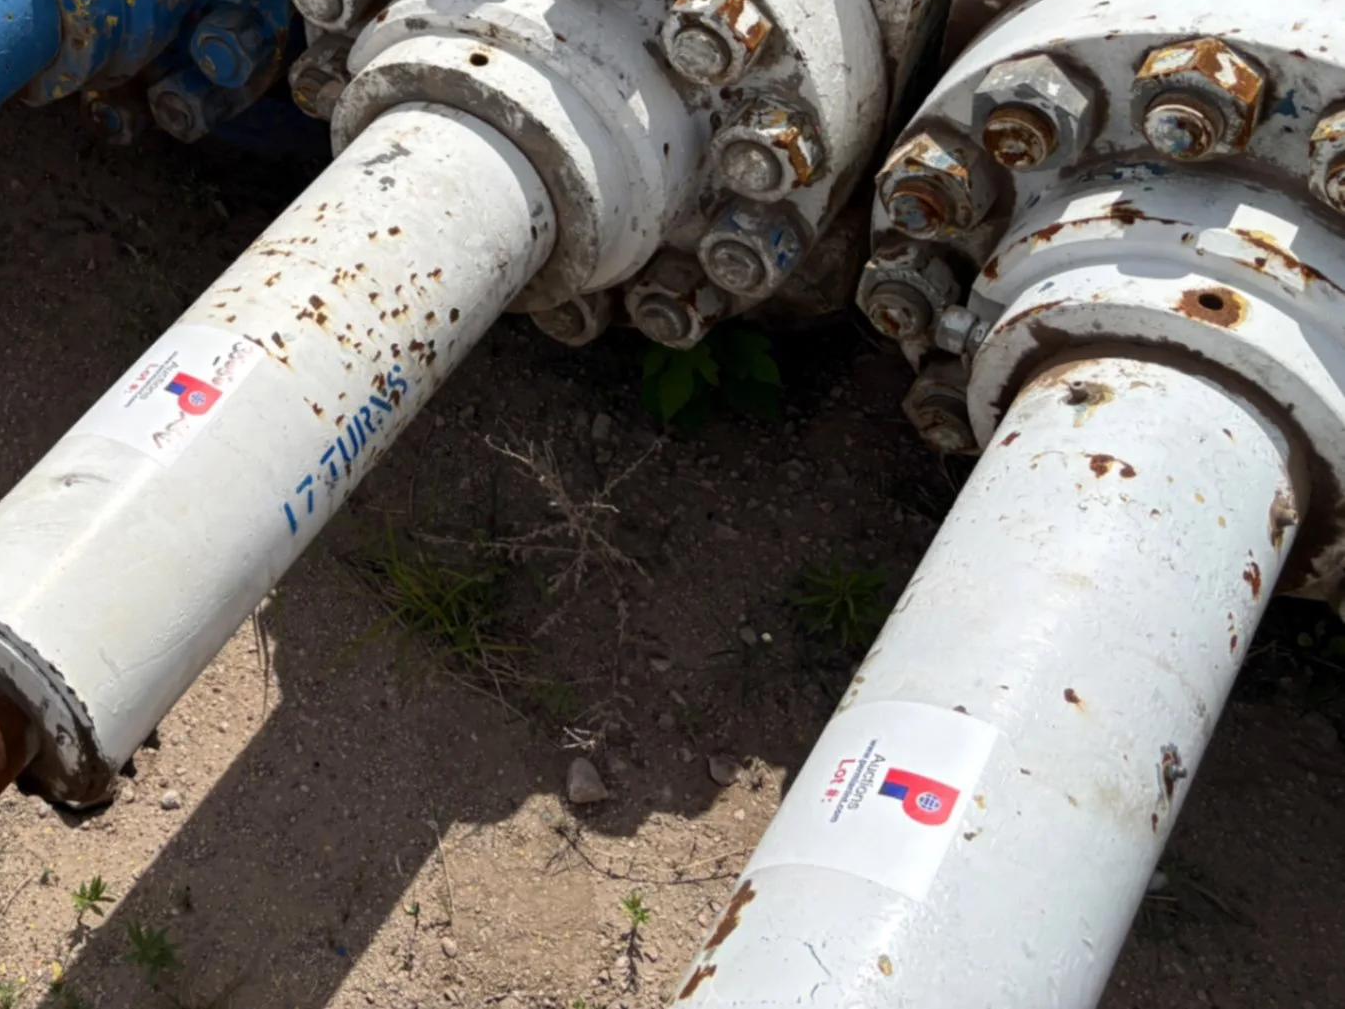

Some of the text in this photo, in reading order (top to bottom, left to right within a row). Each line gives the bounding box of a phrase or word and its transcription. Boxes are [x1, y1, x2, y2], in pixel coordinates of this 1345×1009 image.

[283, 364, 408, 535] 17 TURNS
[830, 758, 856, 784] Lot
[847, 753, 886, 810] Auctions
